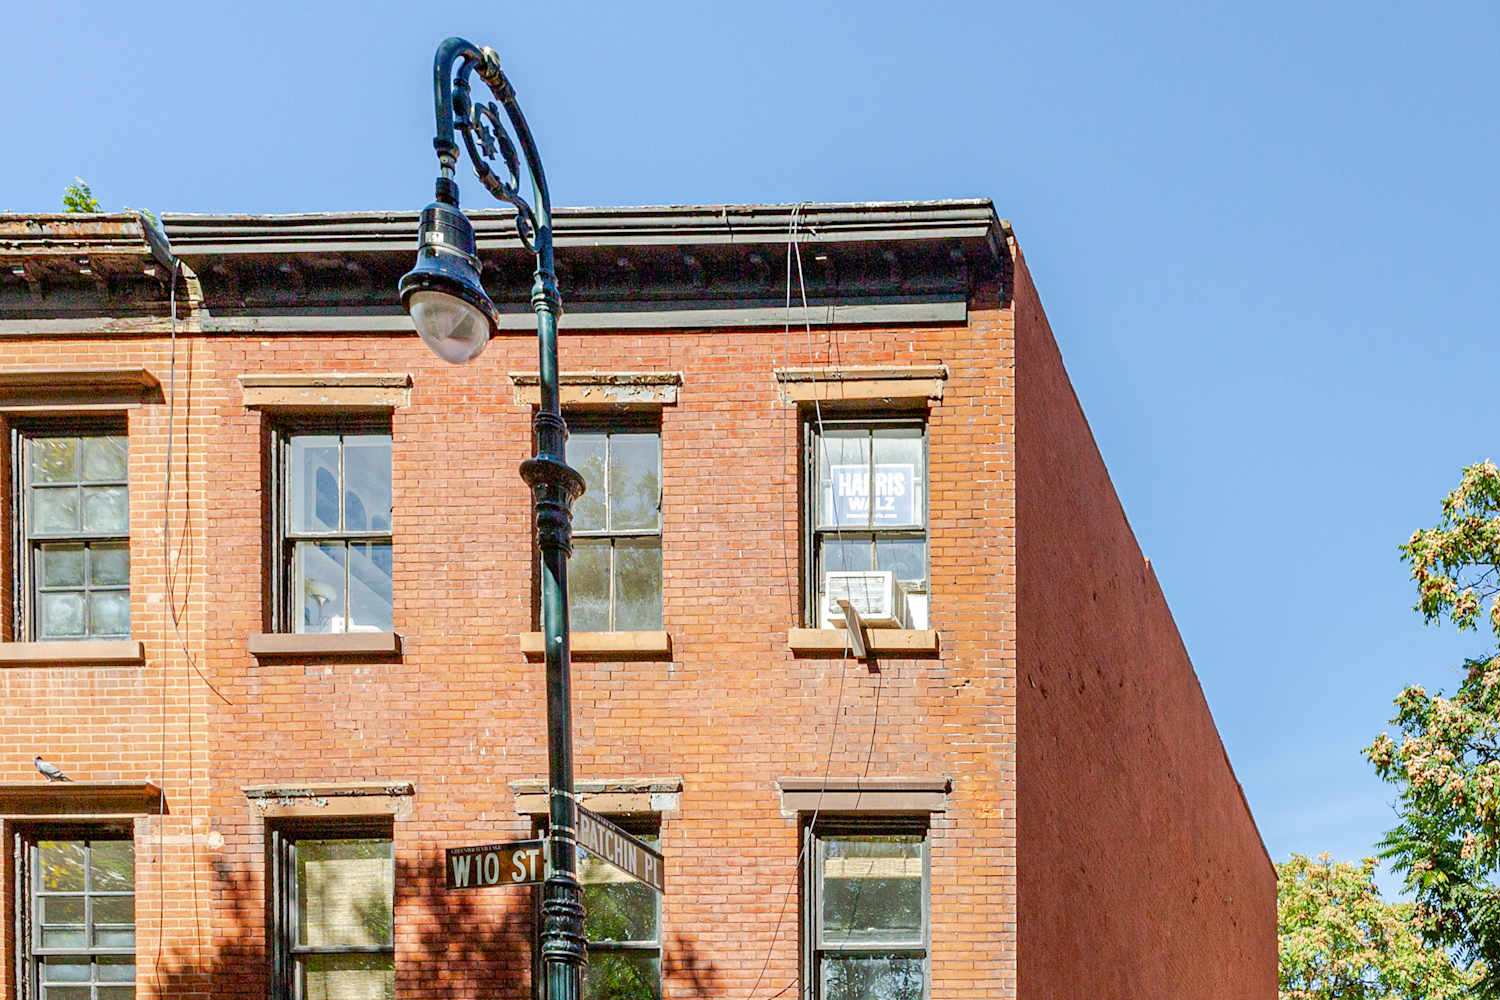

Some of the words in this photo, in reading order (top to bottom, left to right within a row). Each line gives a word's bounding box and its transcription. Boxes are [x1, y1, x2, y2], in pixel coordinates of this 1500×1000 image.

[511, 849, 540, 882] ST
[579, 813, 637, 877] PATCHIN
[643, 852, 660, 888] PL
